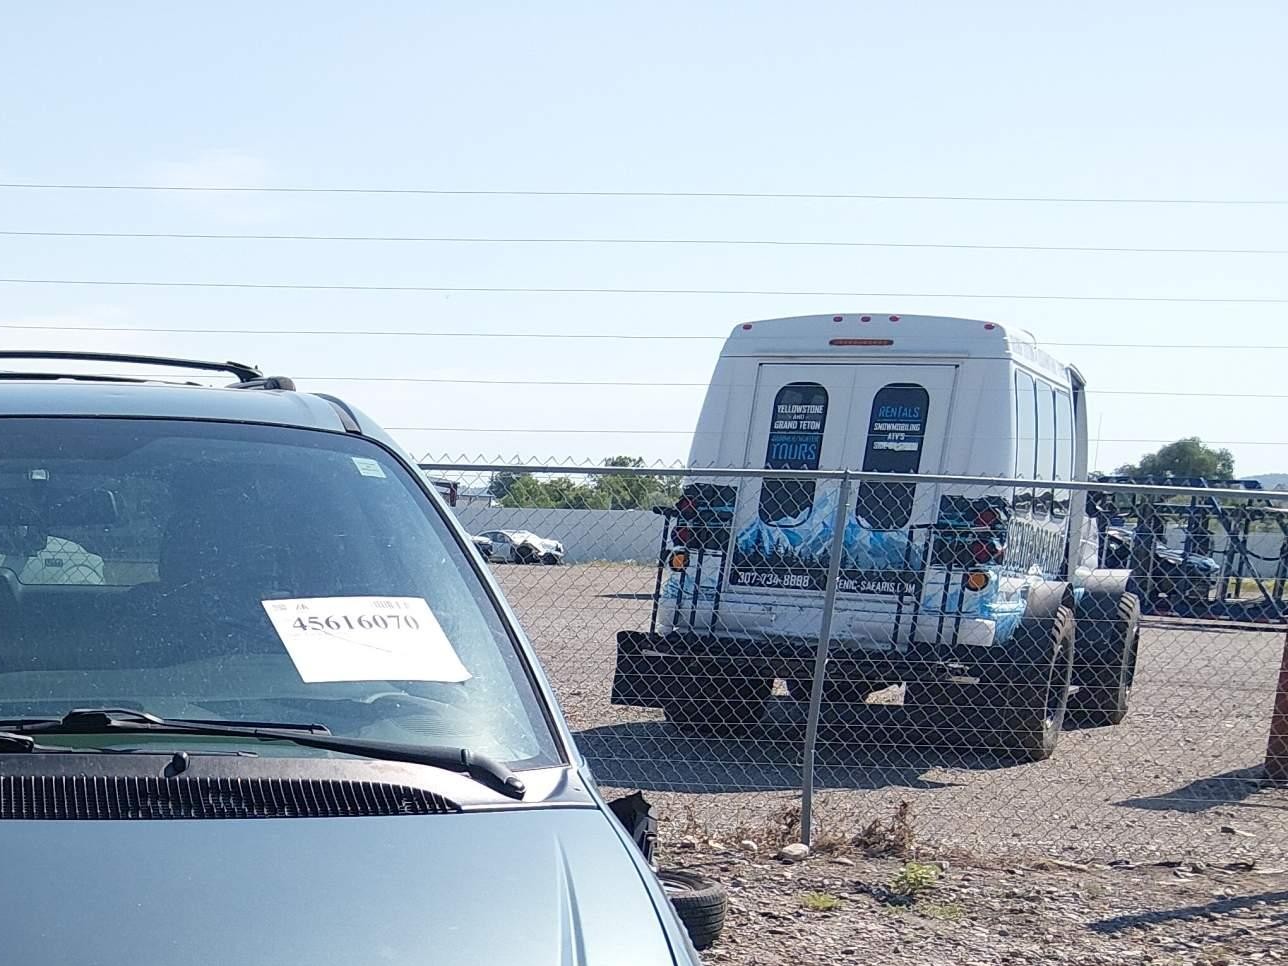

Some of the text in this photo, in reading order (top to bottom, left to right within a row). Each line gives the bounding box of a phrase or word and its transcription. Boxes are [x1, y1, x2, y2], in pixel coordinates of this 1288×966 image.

[777, 404, 824, 414] YELLOWSTONE
[878, 405, 920, 418] RENTALS
[773, 420, 821, 430] GRAND TETON
[873, 422, 921, 431] SNOWMOBILING
[772, 442, 817, 460] TOURS
[292, 615, 420, 632] 45616070
